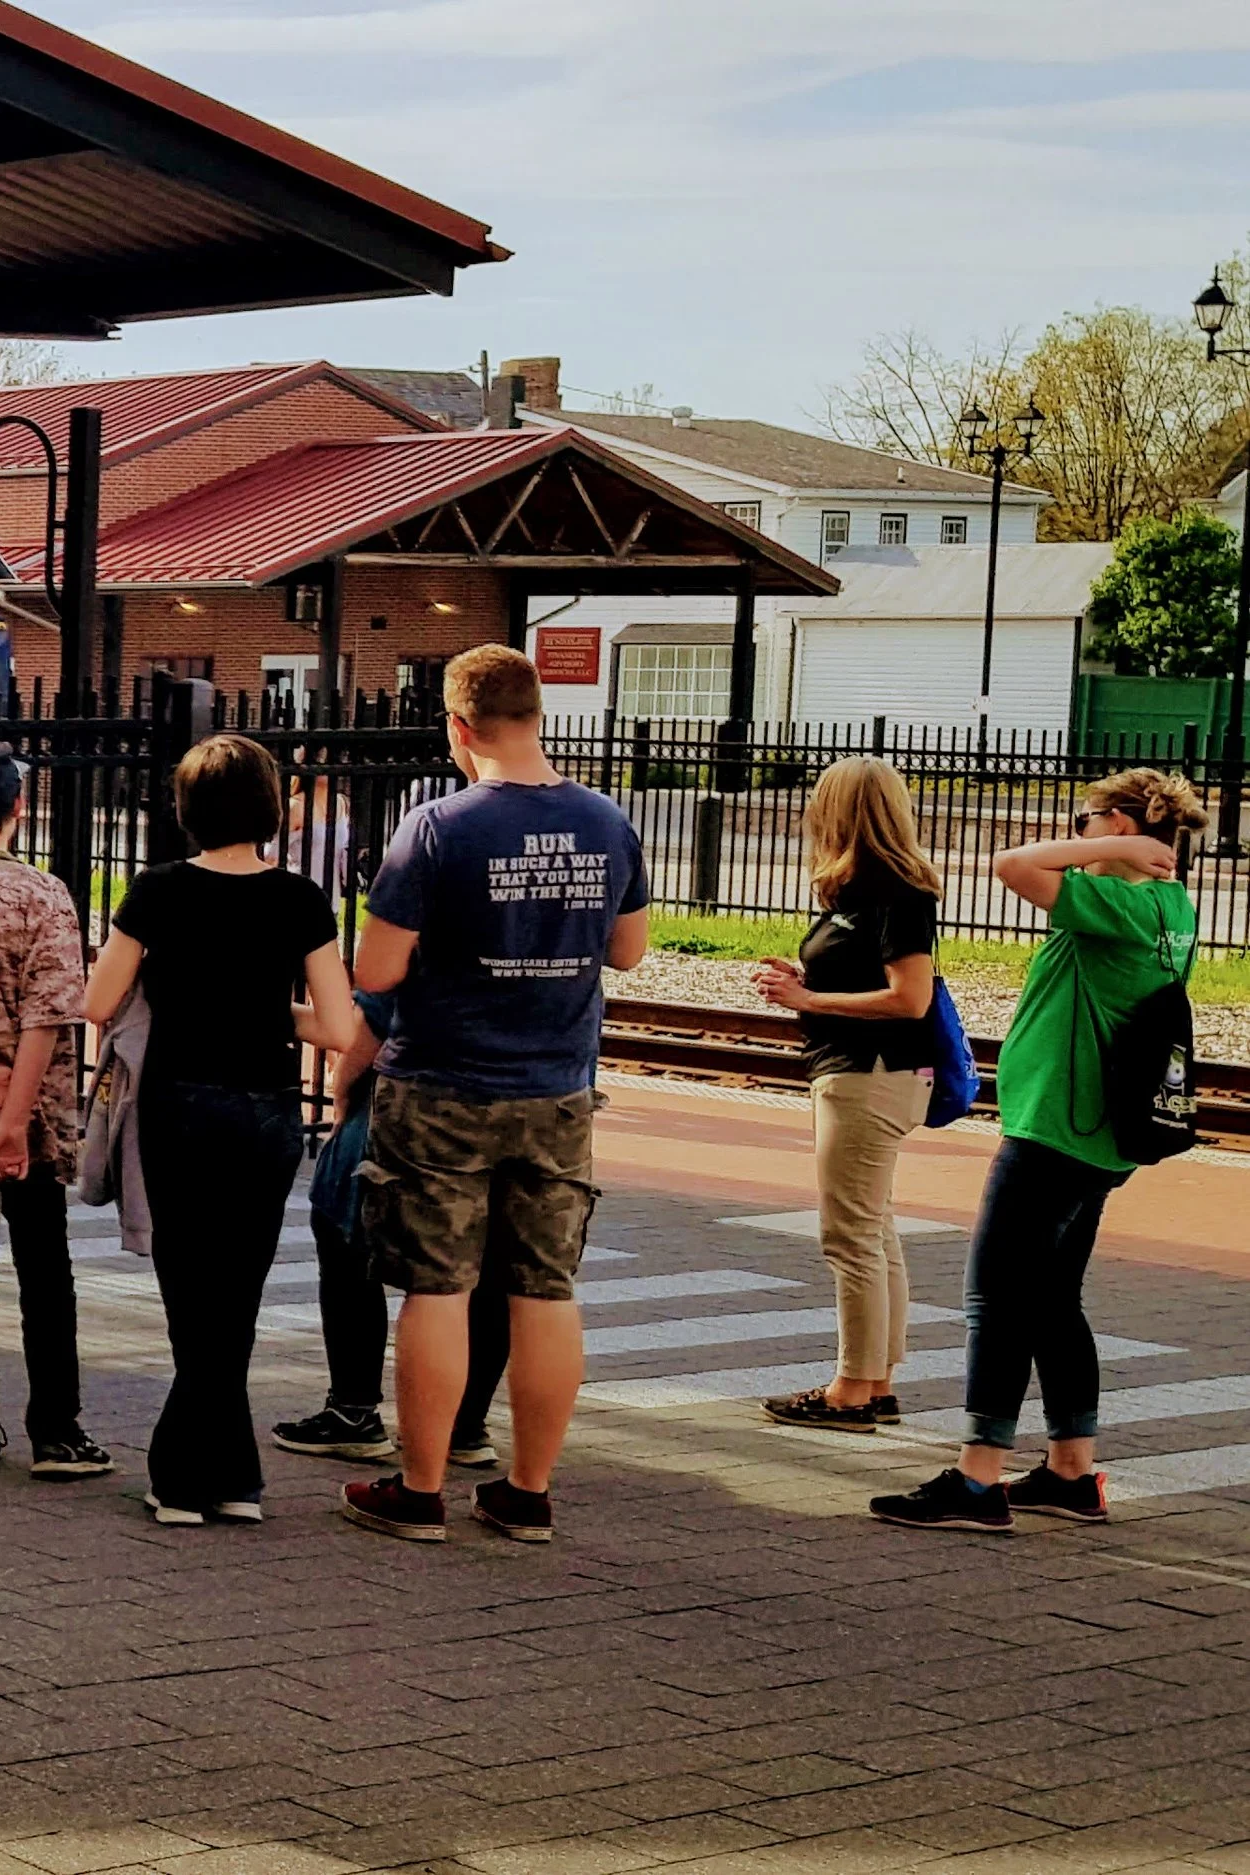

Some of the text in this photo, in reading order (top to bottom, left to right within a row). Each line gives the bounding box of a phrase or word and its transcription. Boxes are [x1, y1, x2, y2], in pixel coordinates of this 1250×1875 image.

[524, 833, 576, 855] RUN
[488, 853, 608, 872] IN SUCH A WAY
[488, 868, 607, 887] THAT YOU MAY
[489, 884, 606, 902] WIN THE PRIZE
[522, 958, 549, 968] CARE
[550, 957, 579, 968] CENTER
